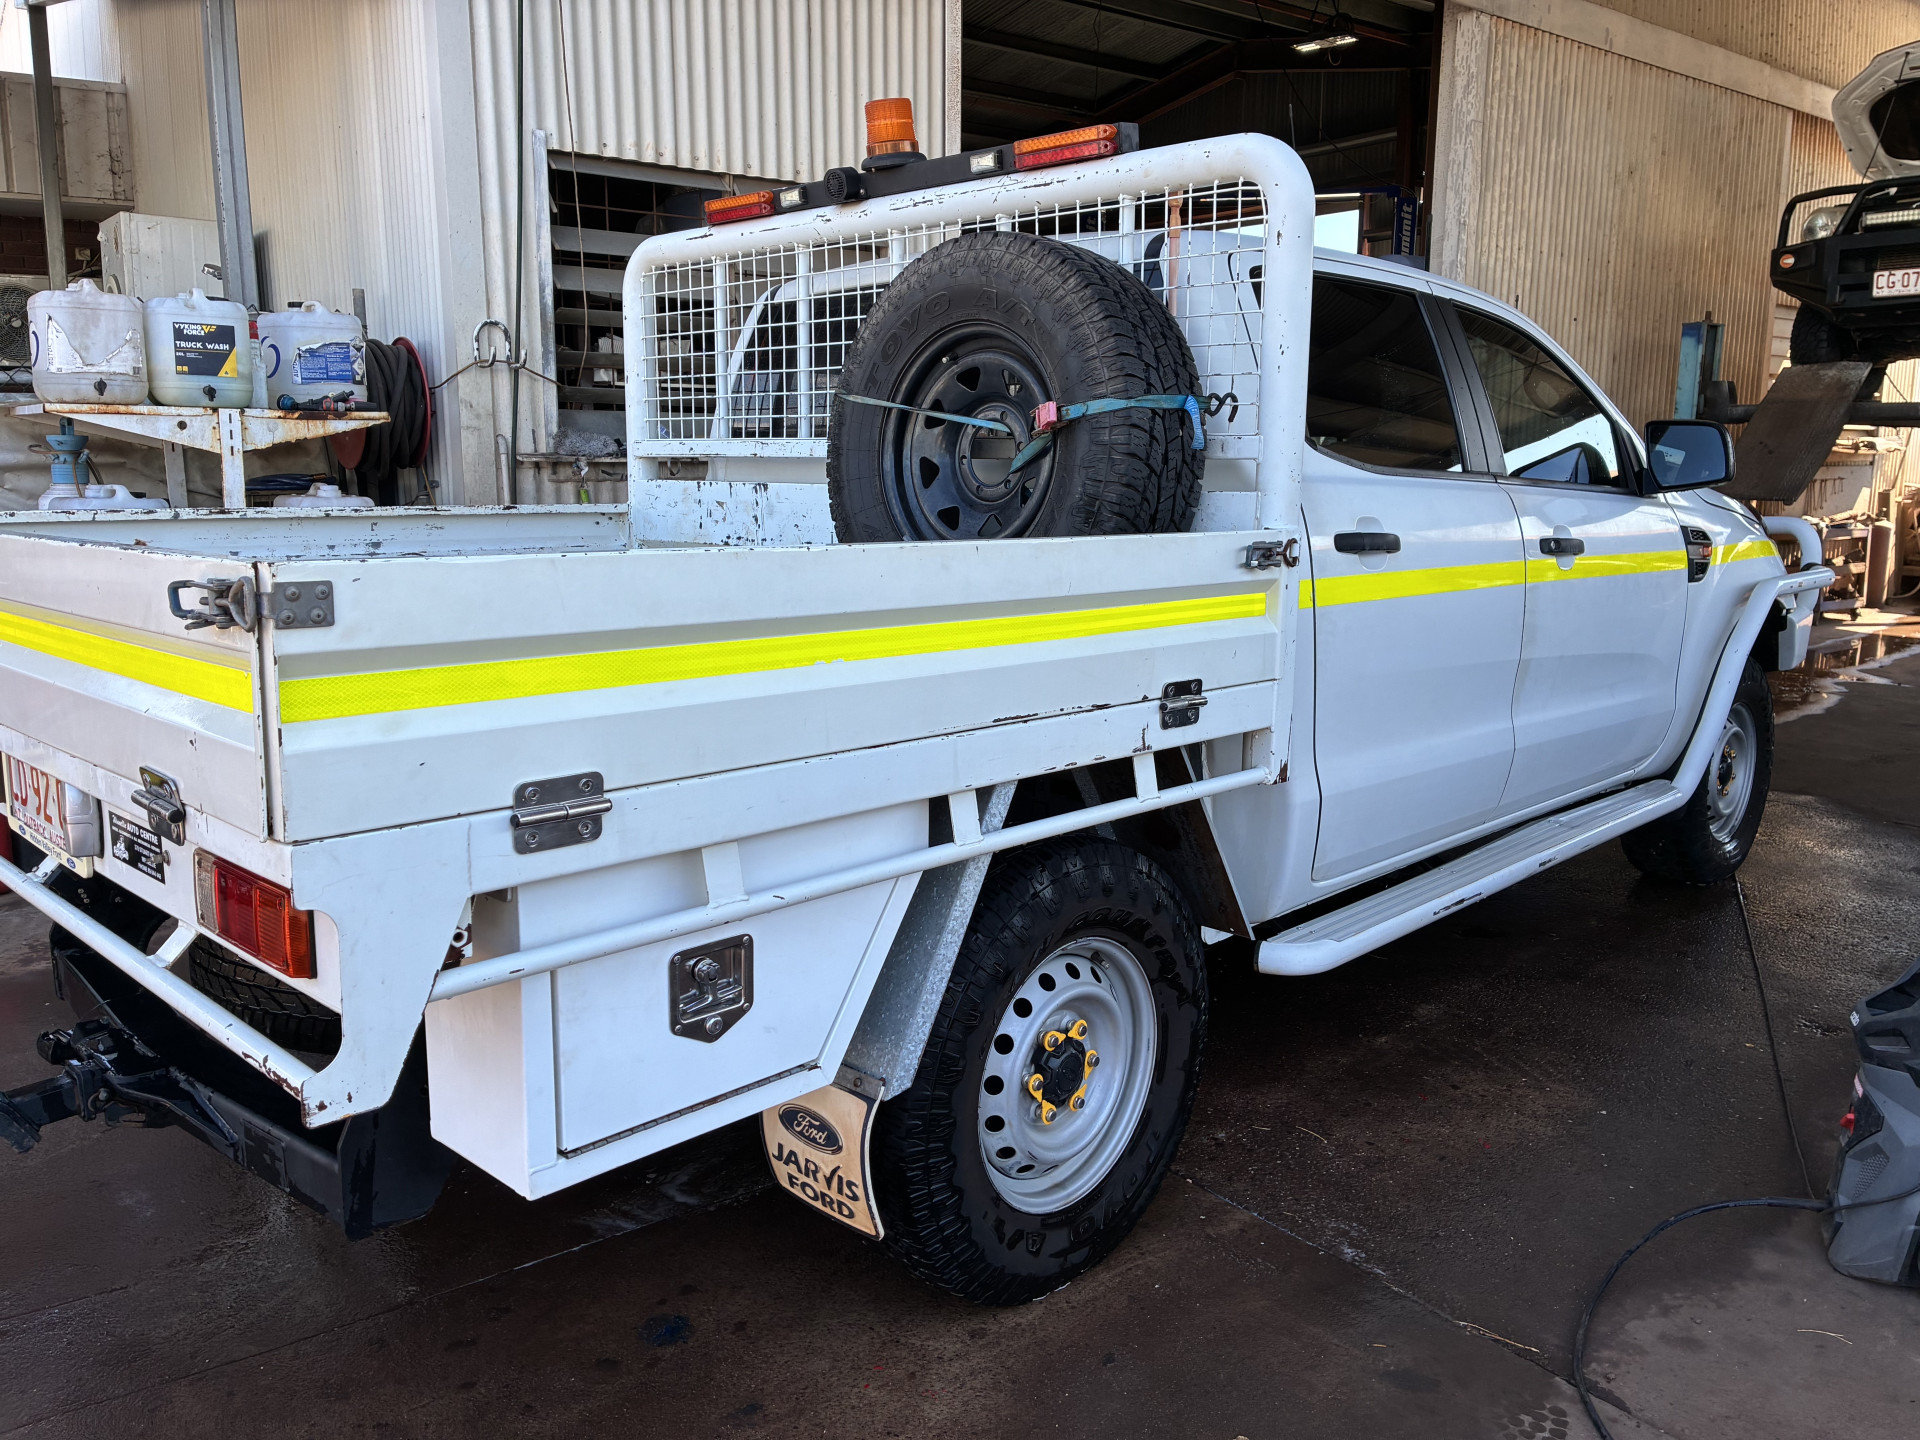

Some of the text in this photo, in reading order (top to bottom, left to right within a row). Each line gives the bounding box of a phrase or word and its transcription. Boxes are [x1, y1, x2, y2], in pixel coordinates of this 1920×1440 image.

[173, 322, 202, 330] VYKING
[183, 328, 205, 336] FORCE
[175, 340, 230, 351] TRUCK WASH
[127, 822, 139, 836] AUTO
[139, 828, 159, 846] CENTRE
[793, 1112, 828, 1145] Ford
[771, 1142, 860, 1202] JARVIS
[787, 1172, 855, 1220] FORD
